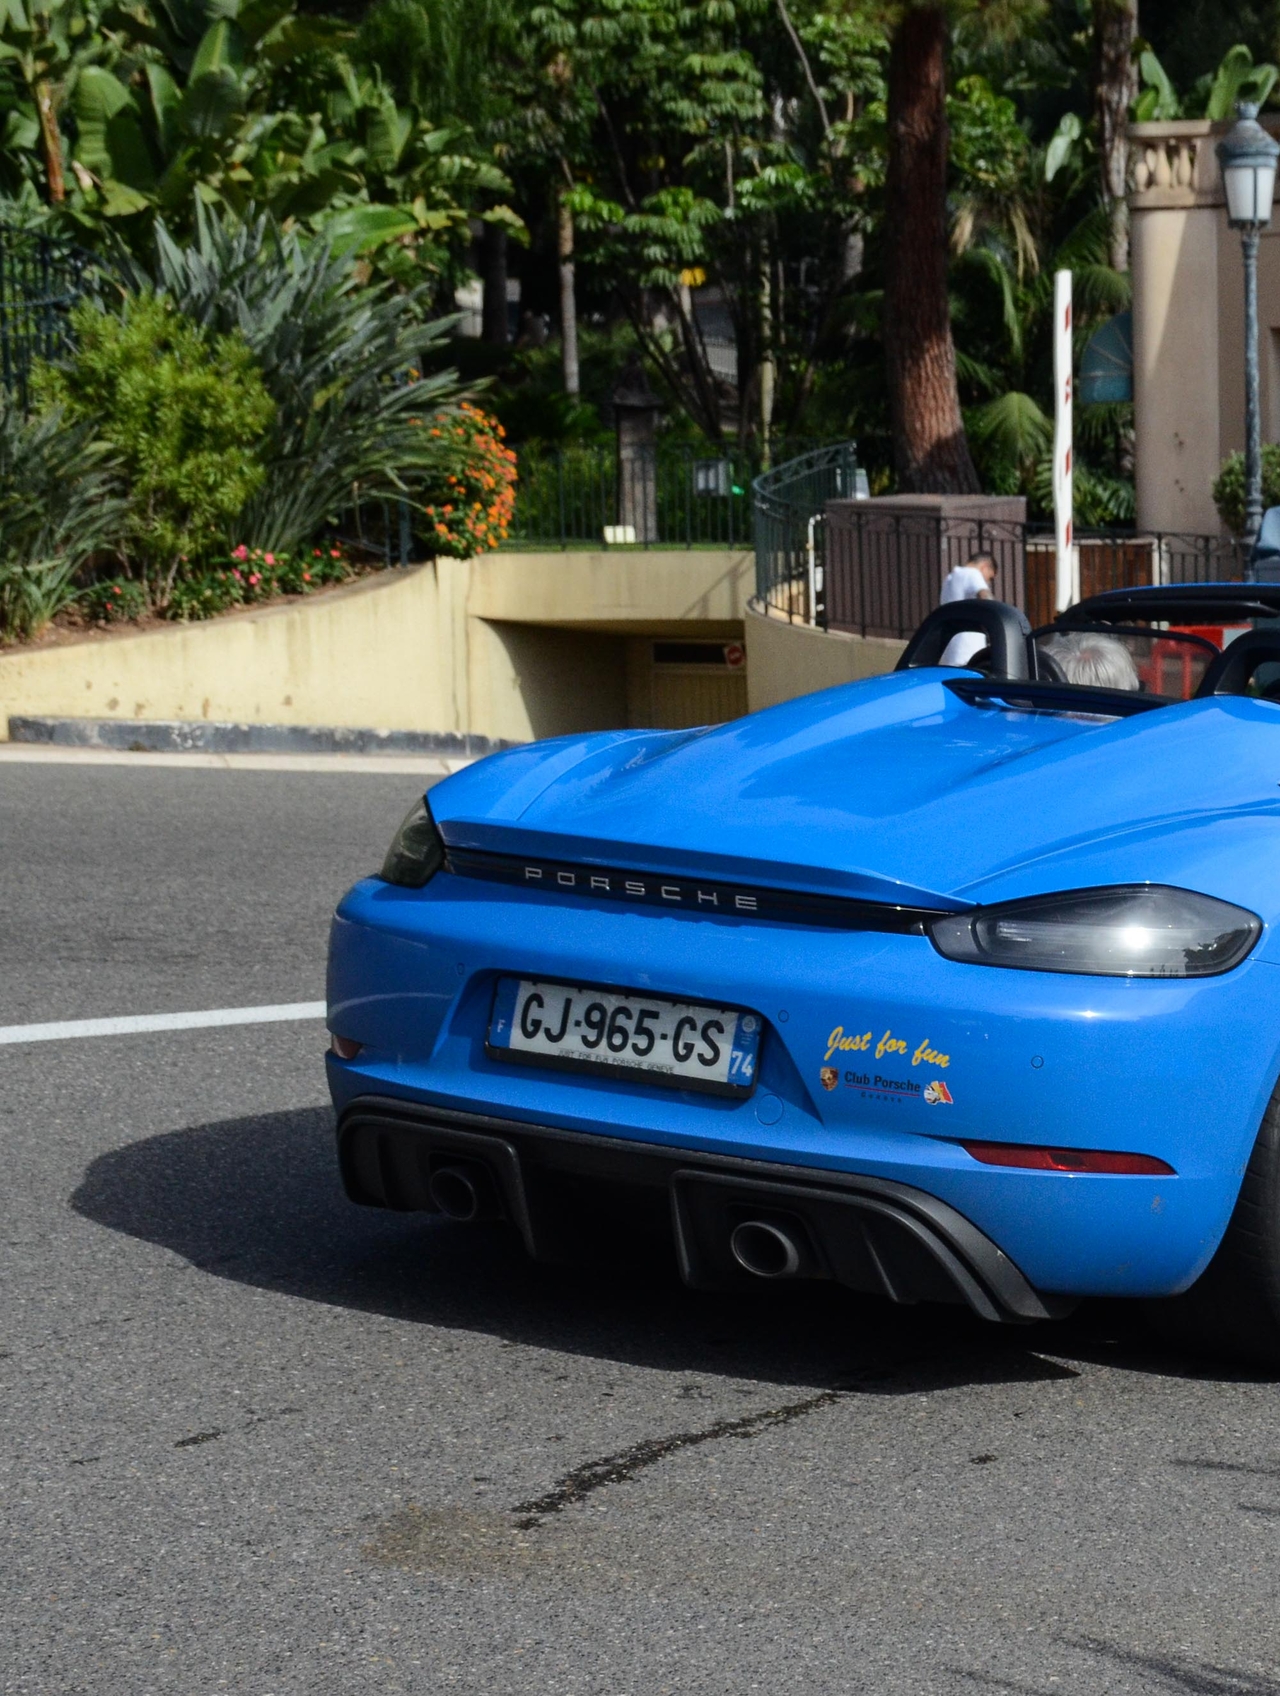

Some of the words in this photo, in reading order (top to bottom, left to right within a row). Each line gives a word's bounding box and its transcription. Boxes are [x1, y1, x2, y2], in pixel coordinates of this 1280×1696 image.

[525, 866, 758, 911] PORSCHE
[520, 992, 726, 1067] GJ-965-GS
[823, 1025, 873, 1061] Just
[875, 1030, 908, 1060] for
[911, 1038, 950, 1068] fun
[731, 1050, 754, 1077] 74
[844, 1070, 870, 1086] Club
[873, 1074, 922, 1093] Porsche
